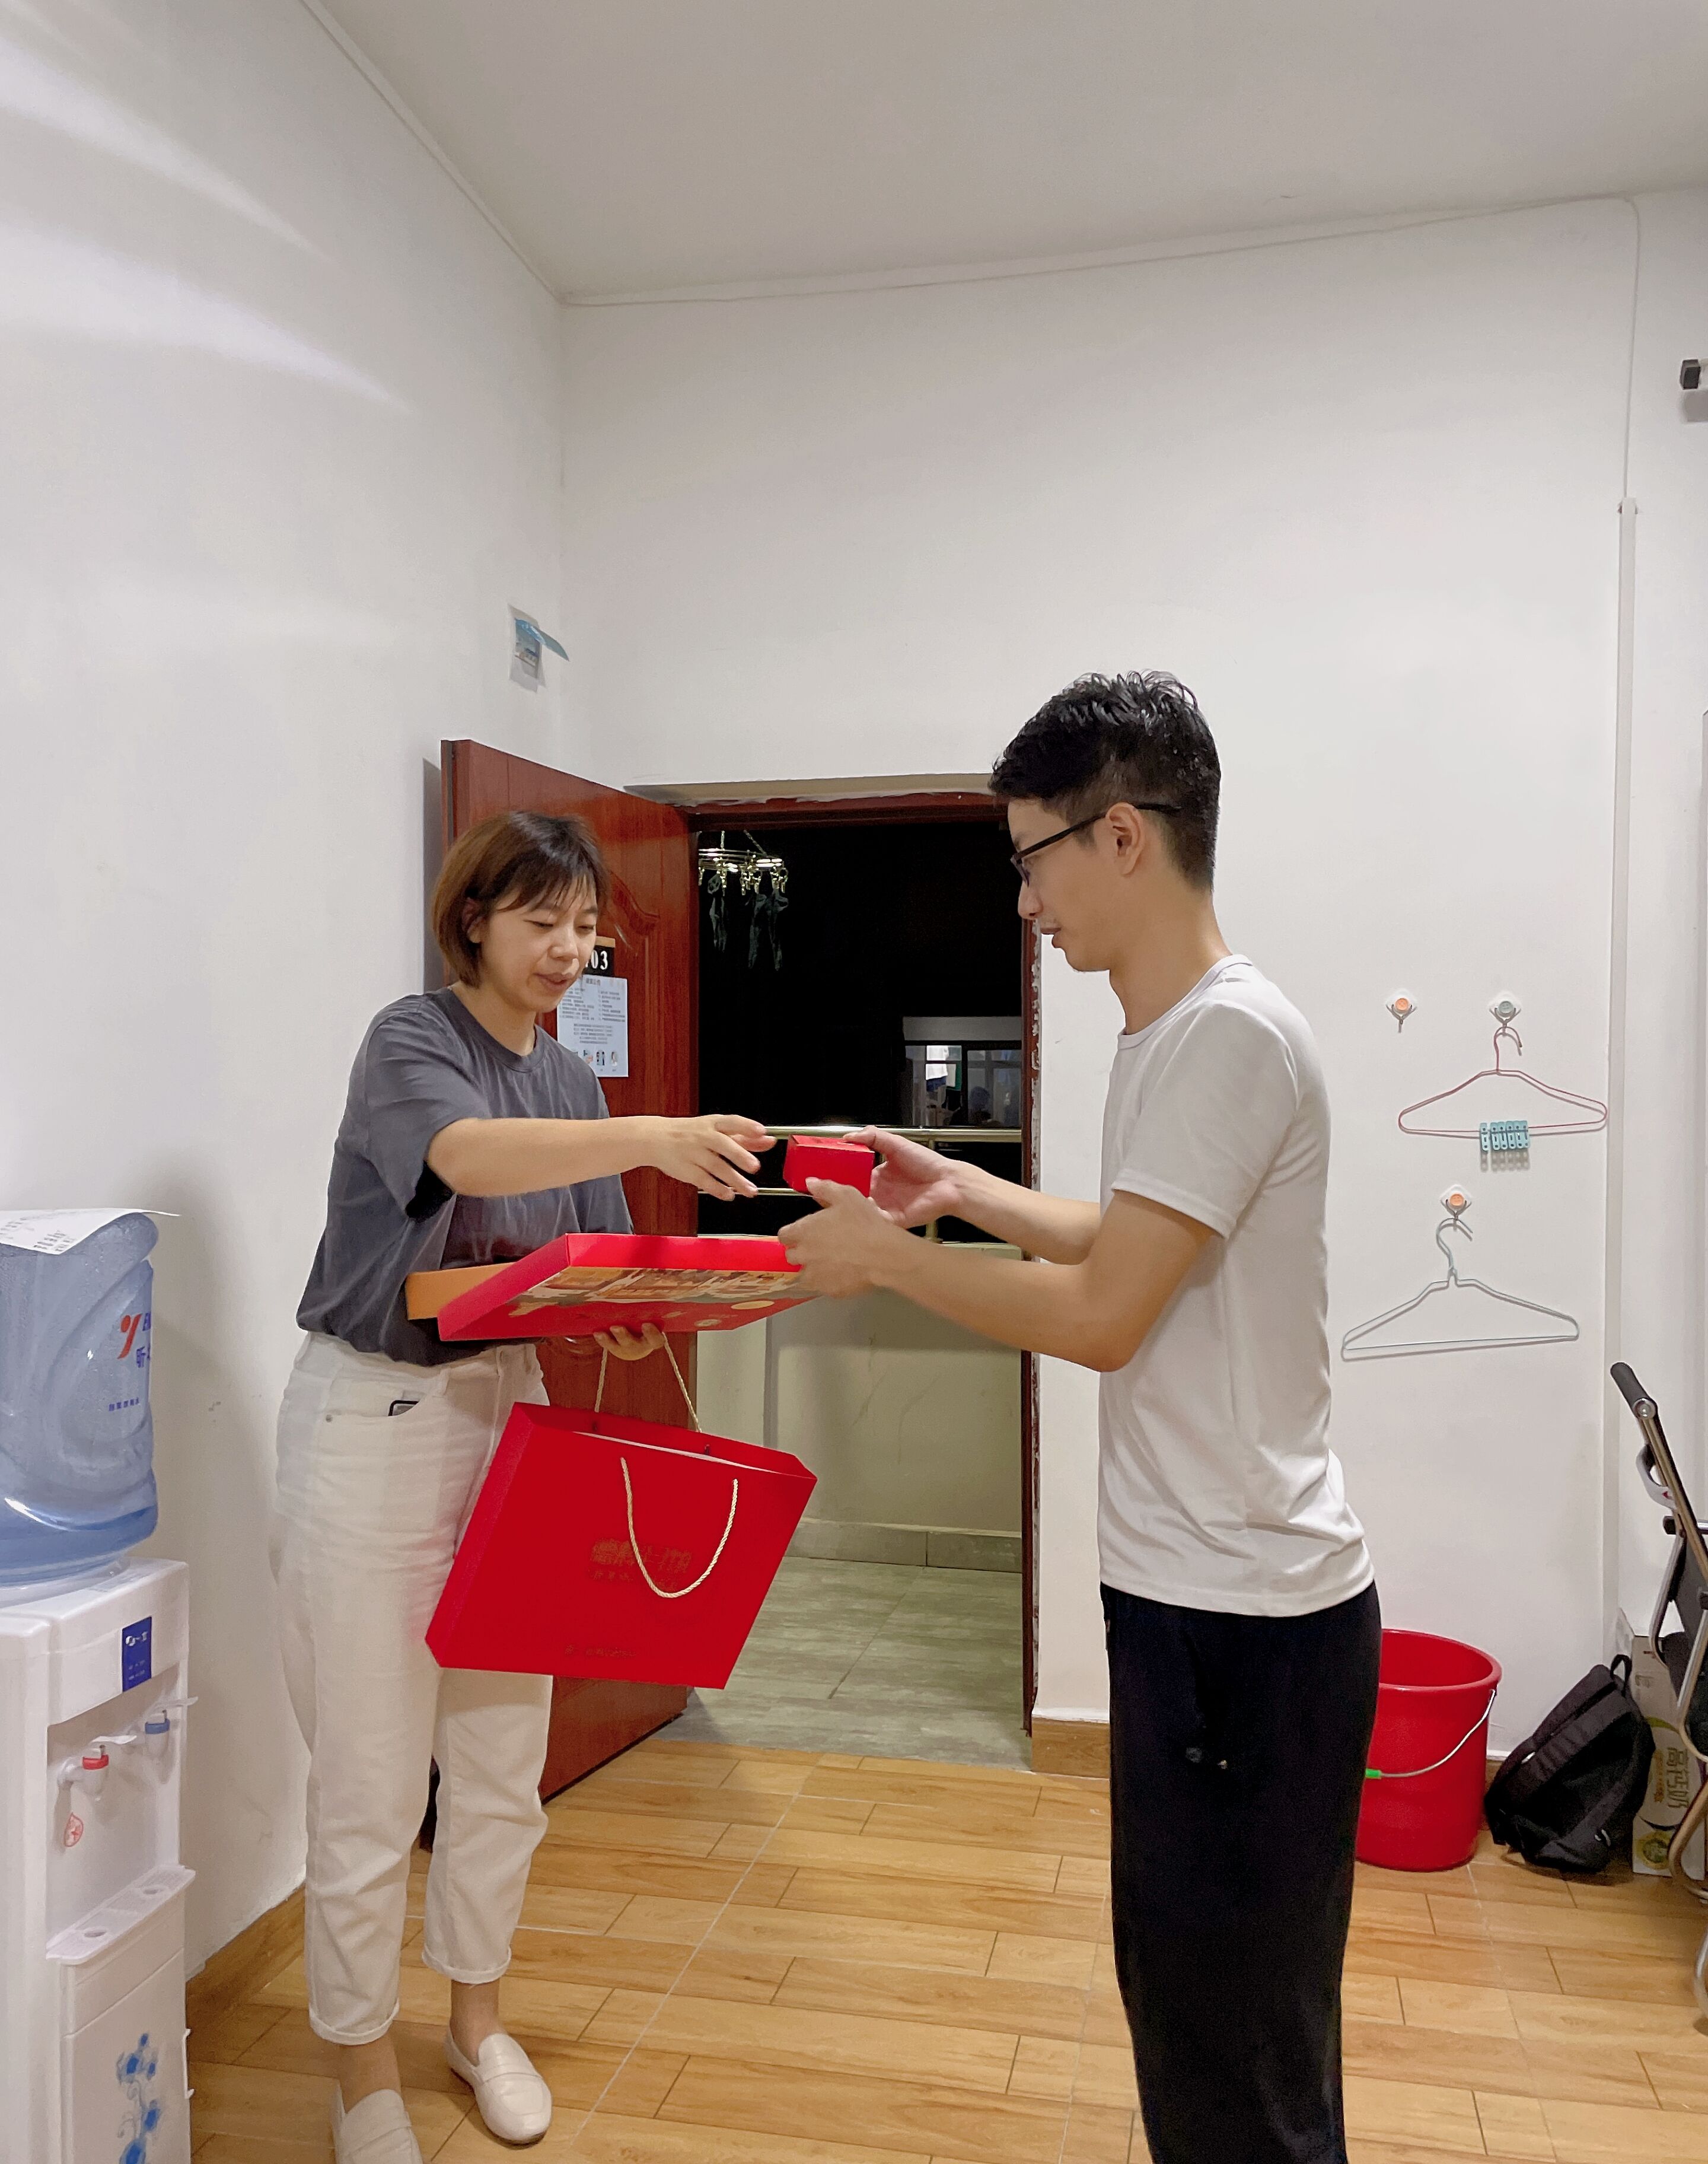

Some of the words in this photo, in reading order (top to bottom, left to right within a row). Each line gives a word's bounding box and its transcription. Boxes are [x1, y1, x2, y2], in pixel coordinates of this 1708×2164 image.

[585, 950, 608, 970] 03
[1666, 1746, 1690, 1809] 高钙奶
